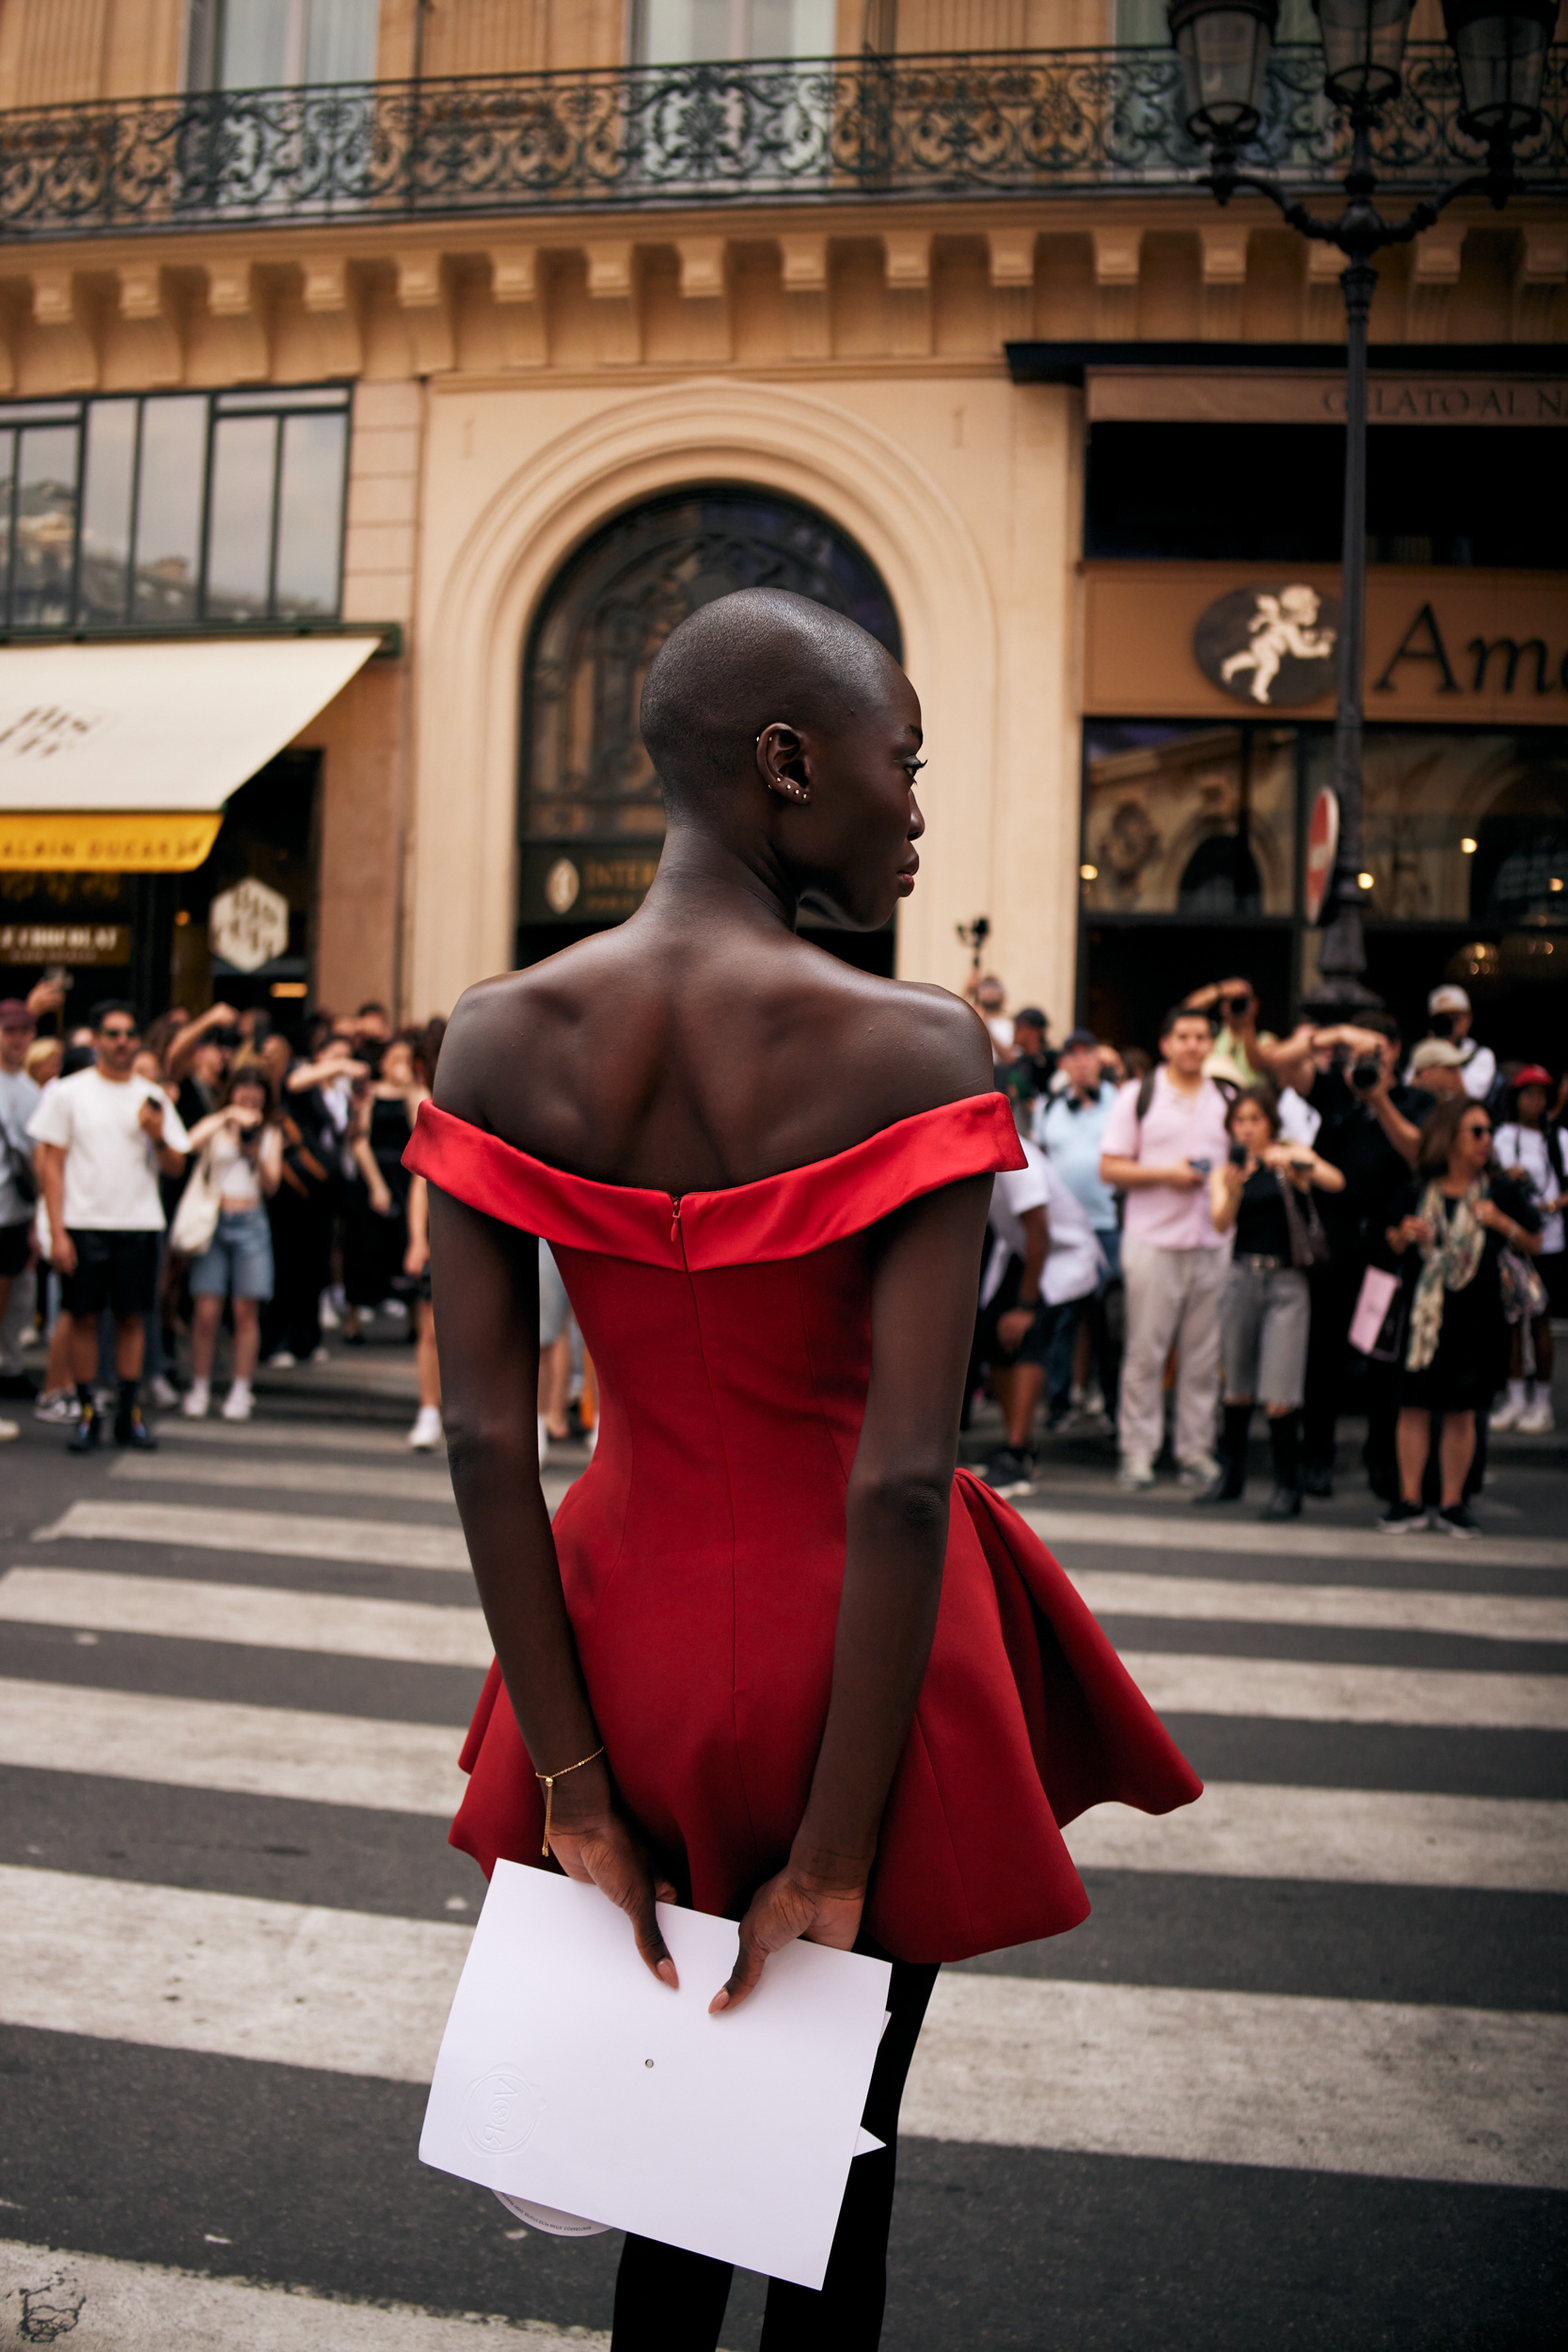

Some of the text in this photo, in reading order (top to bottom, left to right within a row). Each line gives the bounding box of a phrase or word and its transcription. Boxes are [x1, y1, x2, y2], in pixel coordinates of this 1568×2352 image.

[1323, 385, 1568, 418] GLATO AL N
